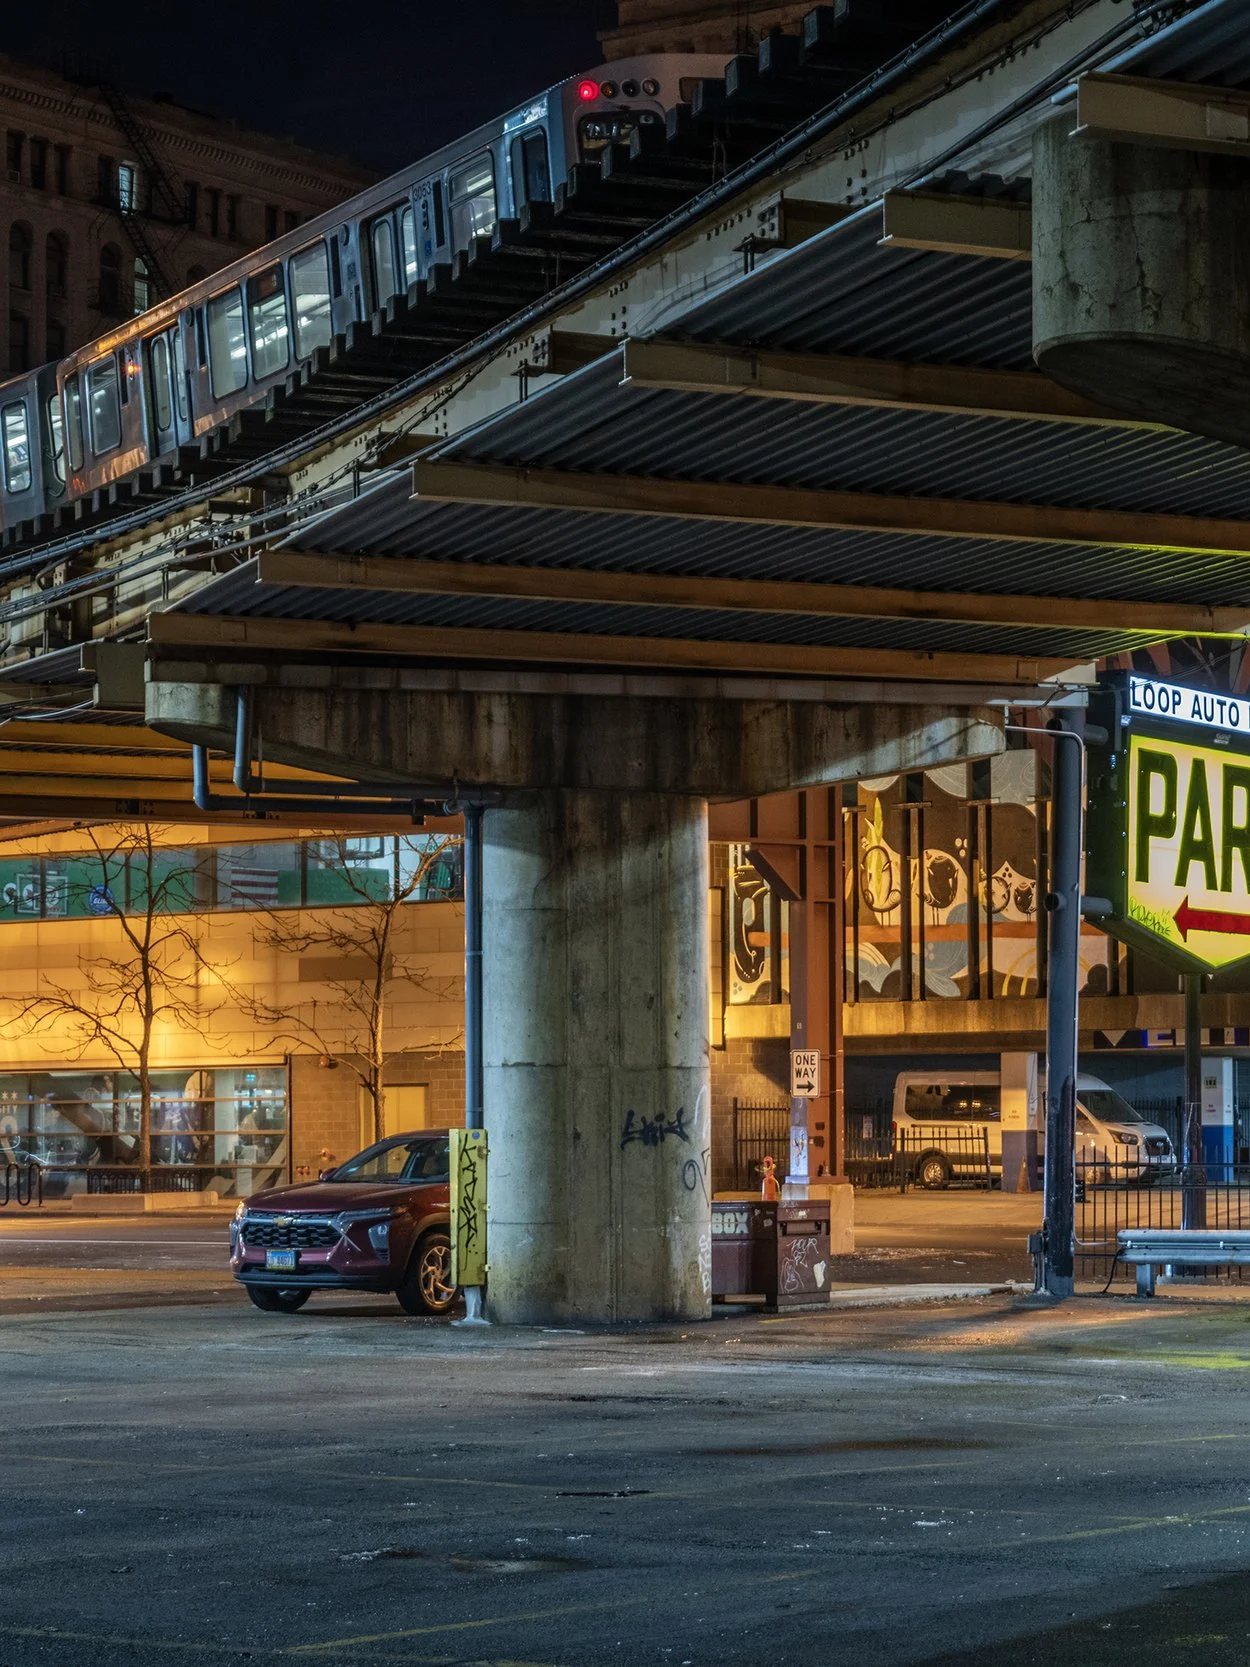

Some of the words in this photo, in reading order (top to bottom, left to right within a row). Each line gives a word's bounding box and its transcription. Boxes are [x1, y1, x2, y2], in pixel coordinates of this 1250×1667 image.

[1131, 680, 1182, 714] LOOP
[1191, 693, 1240, 727] AUTO
[795, 1054, 816, 1066] ONE
[795, 1067, 816, 1079] WAY
[711, 1211, 749, 1234] BOX
